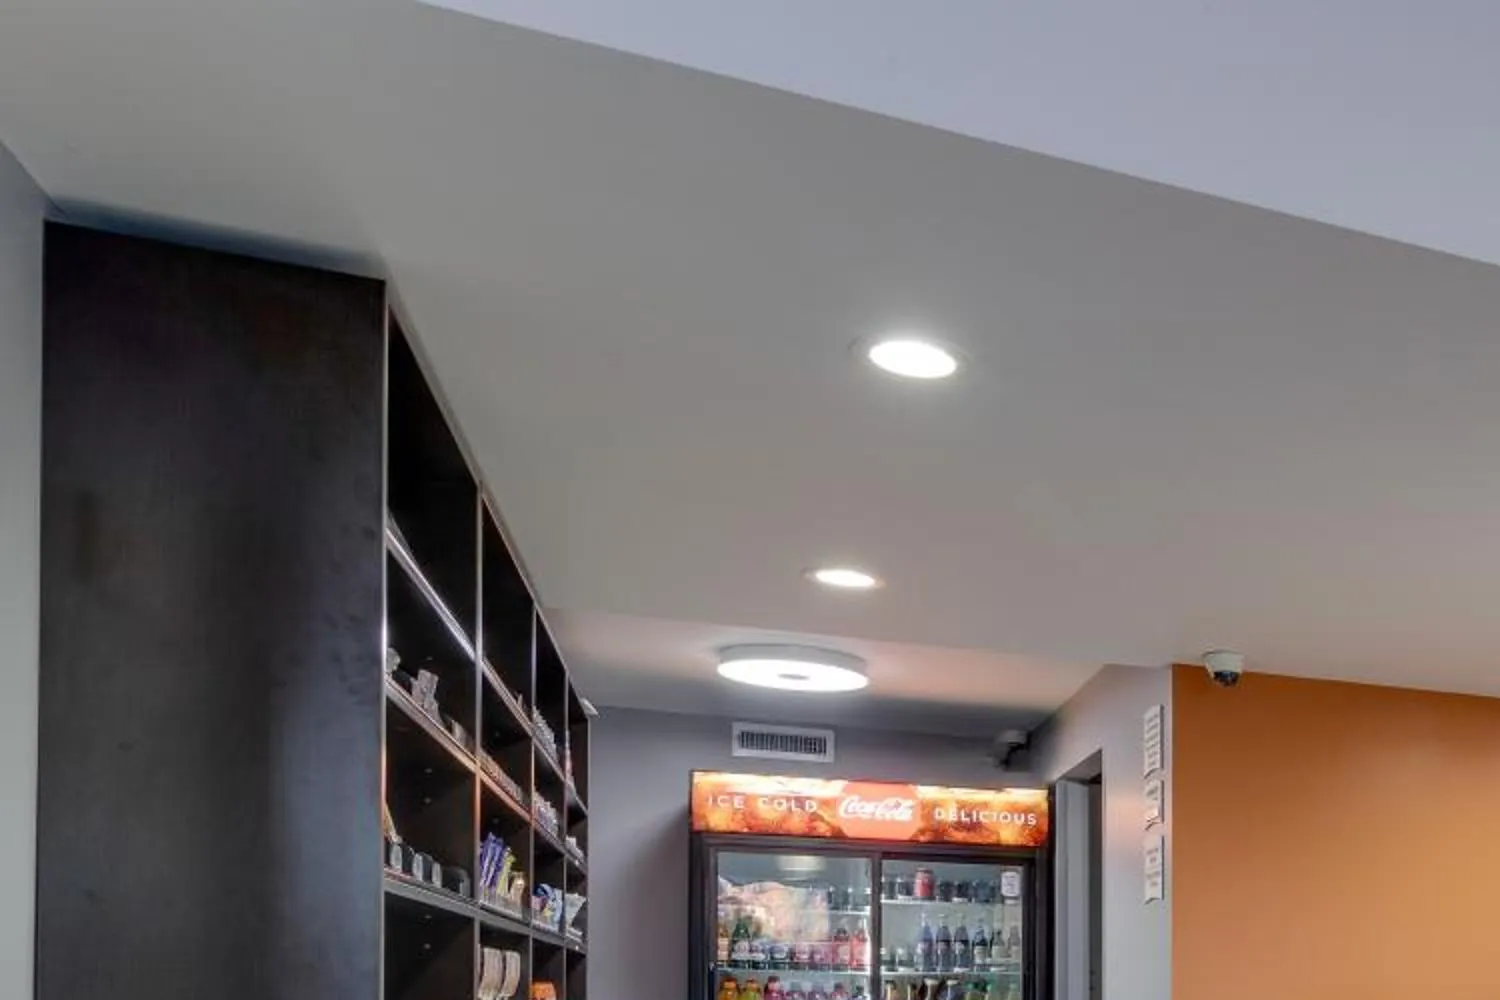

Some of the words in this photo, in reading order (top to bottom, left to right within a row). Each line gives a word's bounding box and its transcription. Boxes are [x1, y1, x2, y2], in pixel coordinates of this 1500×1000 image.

[707, 795, 745, 809] ICE
[758, 797, 817, 813] COLD
[933, 806, 1038, 826] DELICIOUS
